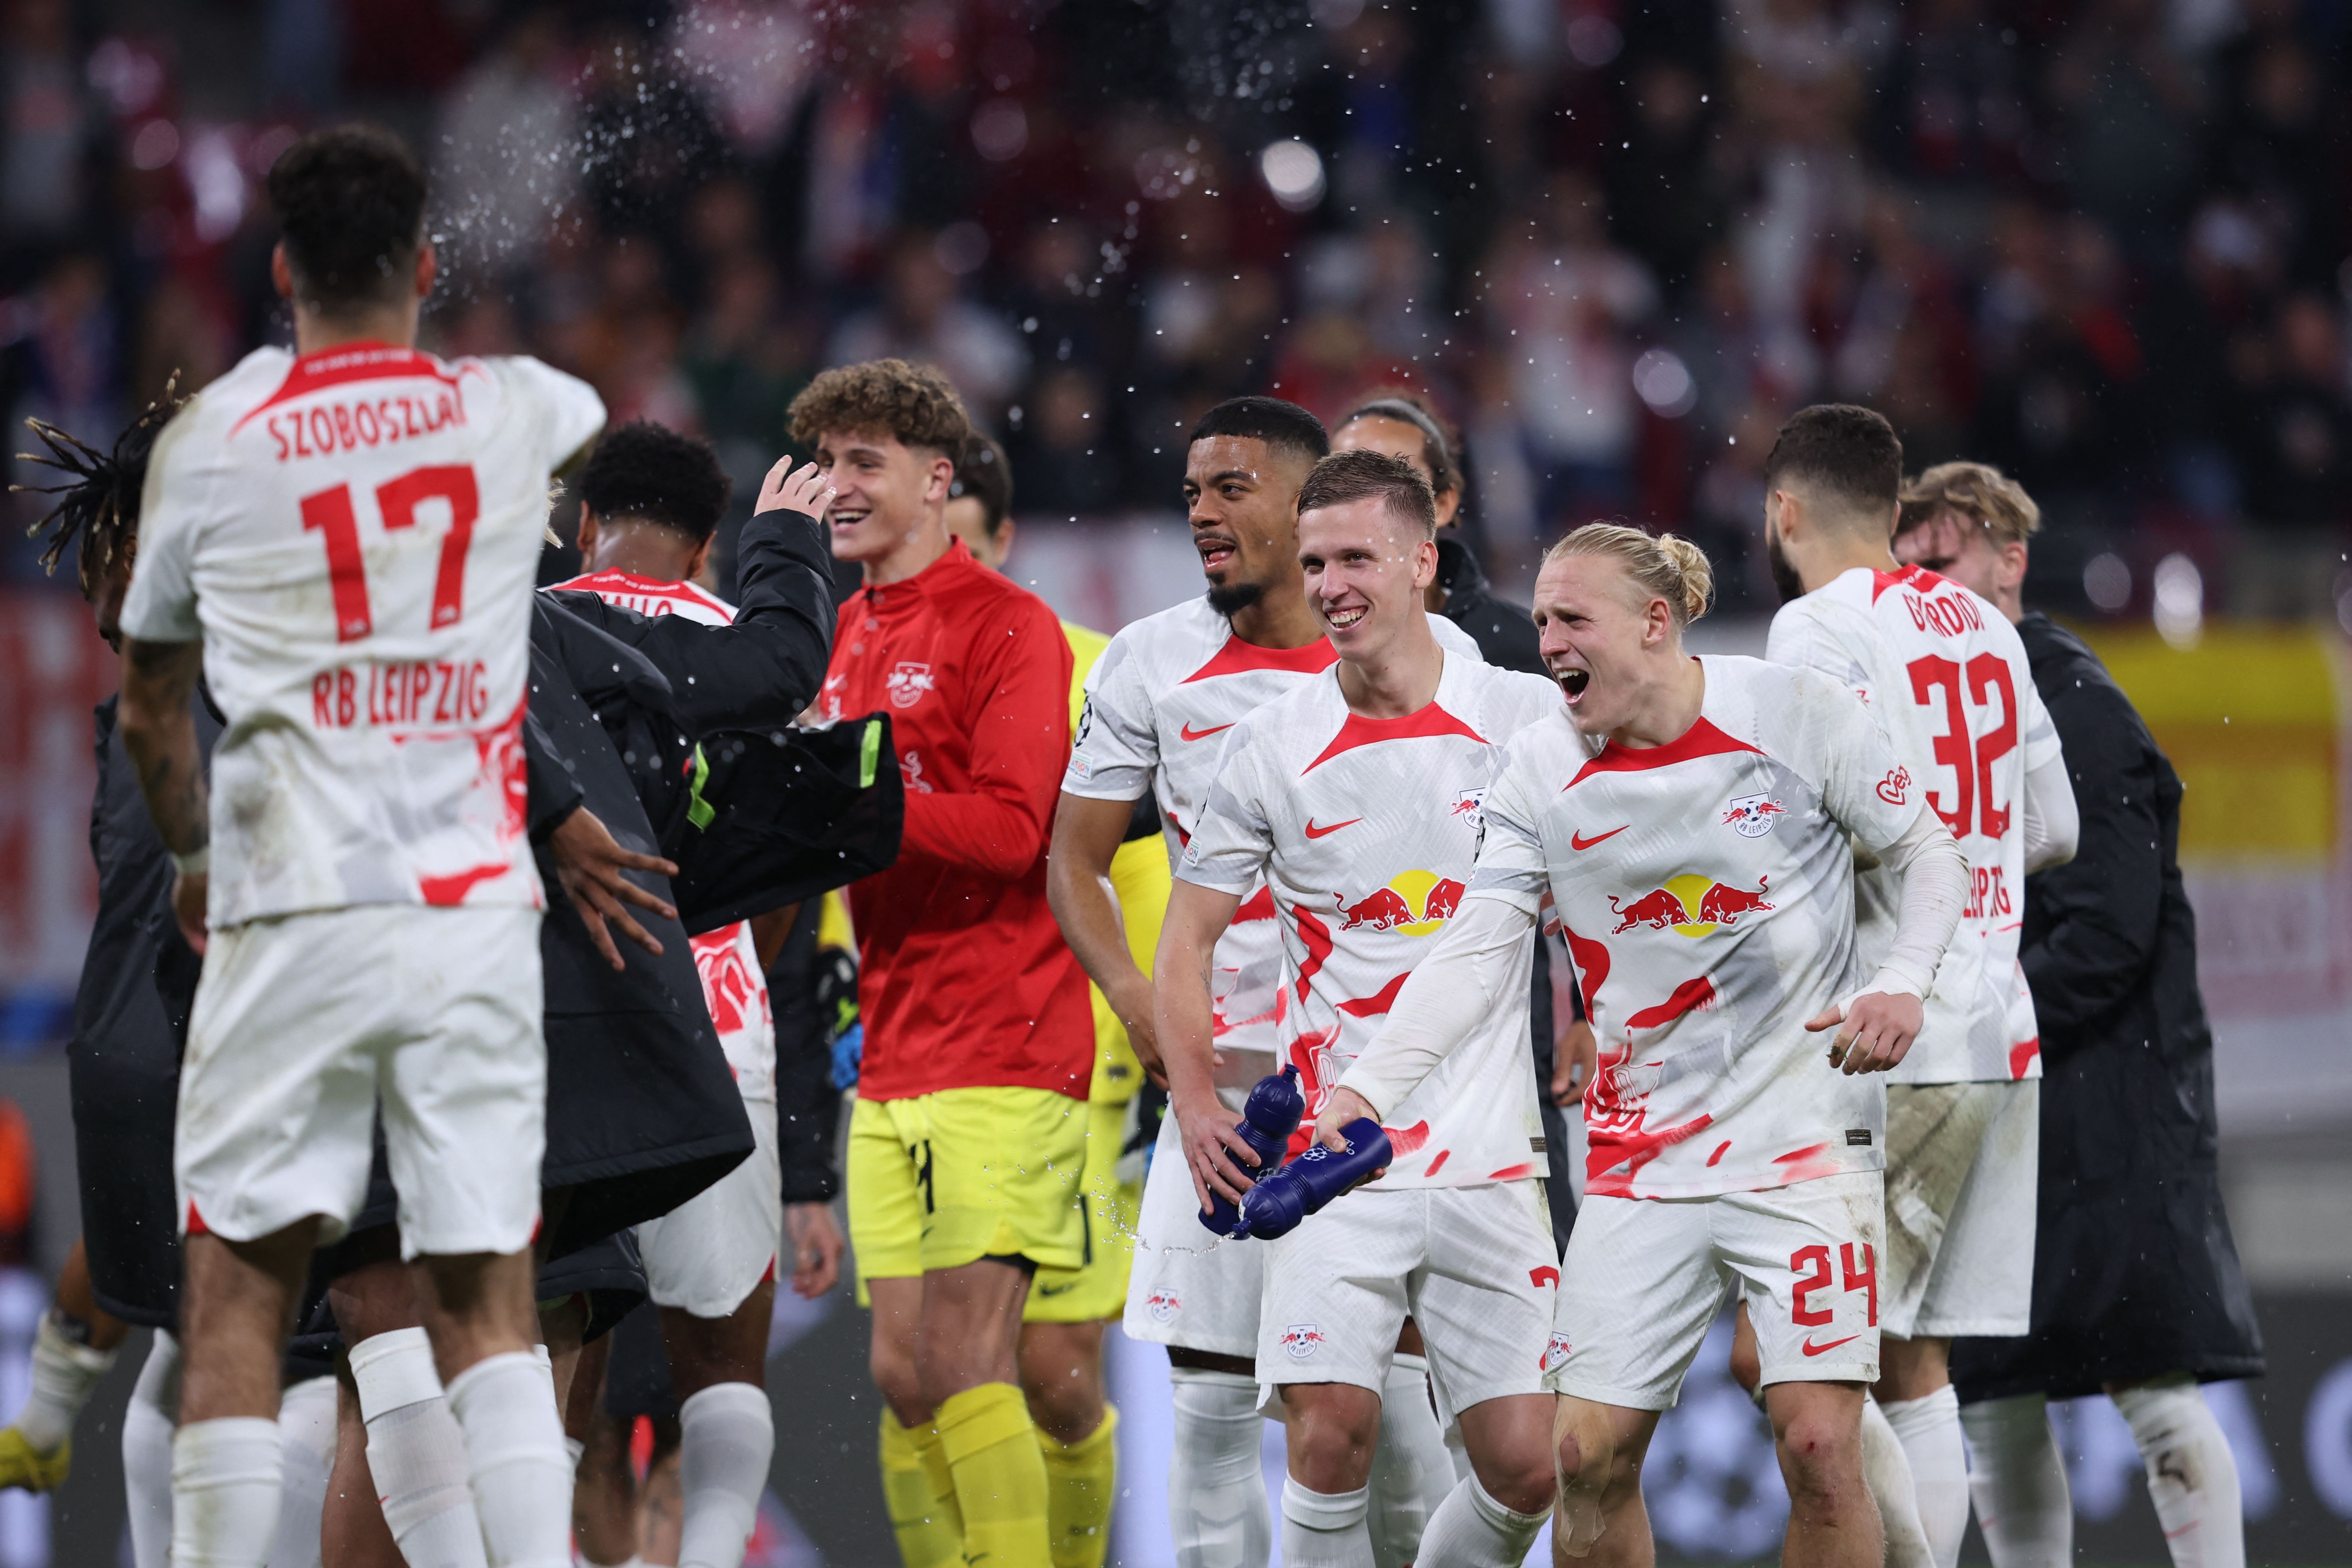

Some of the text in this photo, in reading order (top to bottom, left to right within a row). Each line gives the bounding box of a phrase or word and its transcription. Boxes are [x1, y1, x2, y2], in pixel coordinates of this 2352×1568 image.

[299, 463, 480, 644] 17
[312, 660, 489, 729] RB LEIPZIG
[1907, 651, 2018, 841] 32
[1467, 814, 1476, 823] RB
[1739, 817, 1771, 833] RB LEIPZIG
[1790, 1242, 1877, 1327] 24
